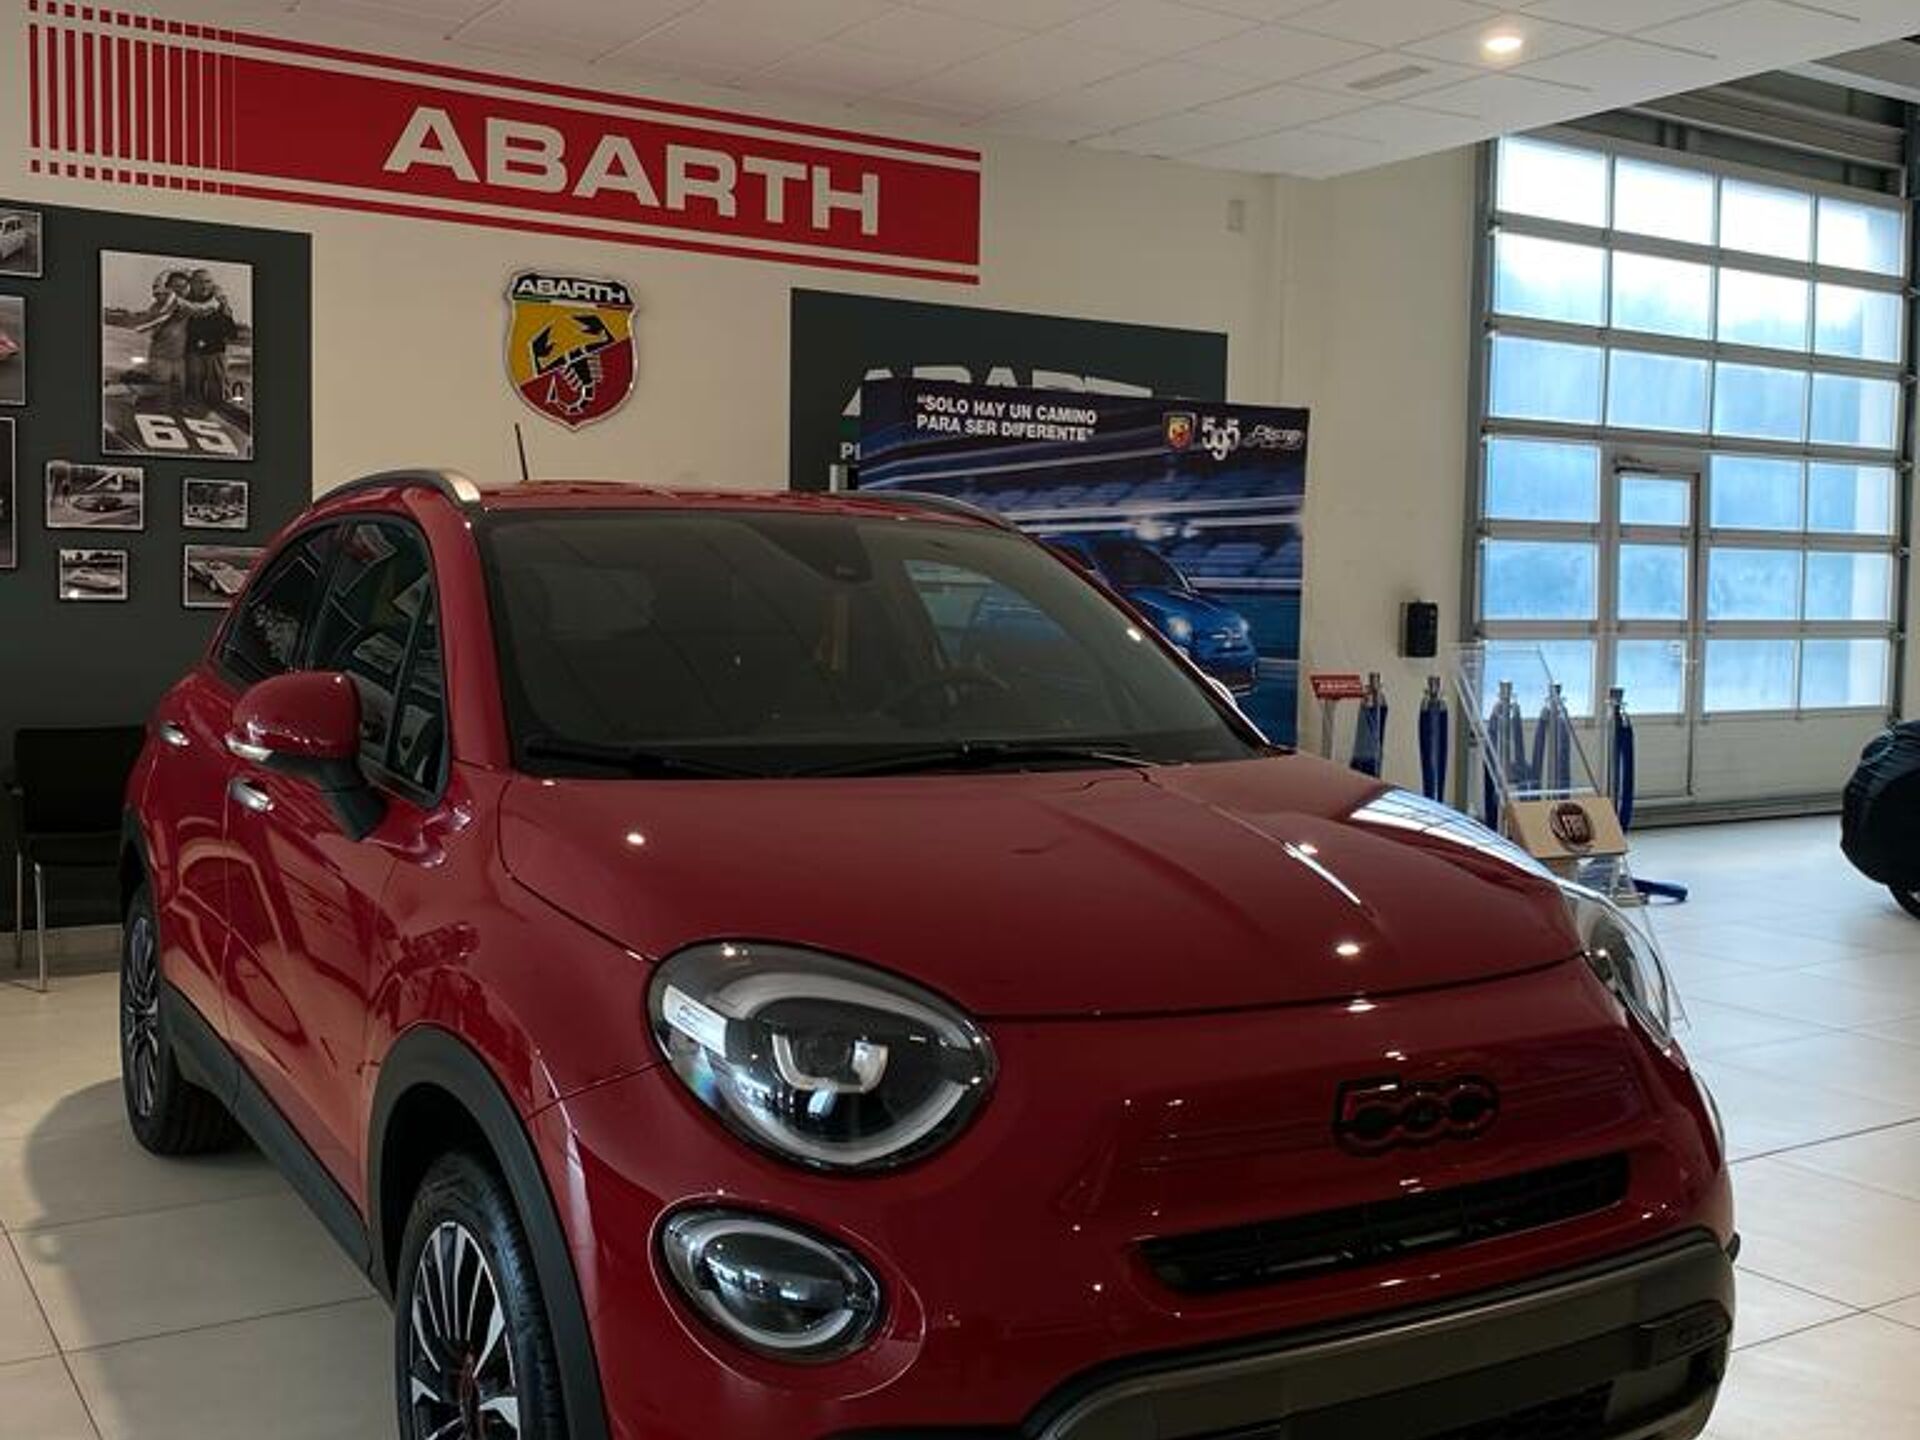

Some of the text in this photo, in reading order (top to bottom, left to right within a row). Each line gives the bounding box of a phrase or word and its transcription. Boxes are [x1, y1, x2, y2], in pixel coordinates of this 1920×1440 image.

[382, 106, 879, 236] ABARTH
[518, 279, 625, 303] ABARTH
[917, 414, 961, 432] PARA
[965, 419, 998, 436] SER
[974, 400, 1005, 418] HAY
[1009, 404, 1032, 420] UN
[1036, 405, 1097, 425] CAMINO
[135, 414, 239, 456] 65
[1334, 1076, 1498, 1158] 500
